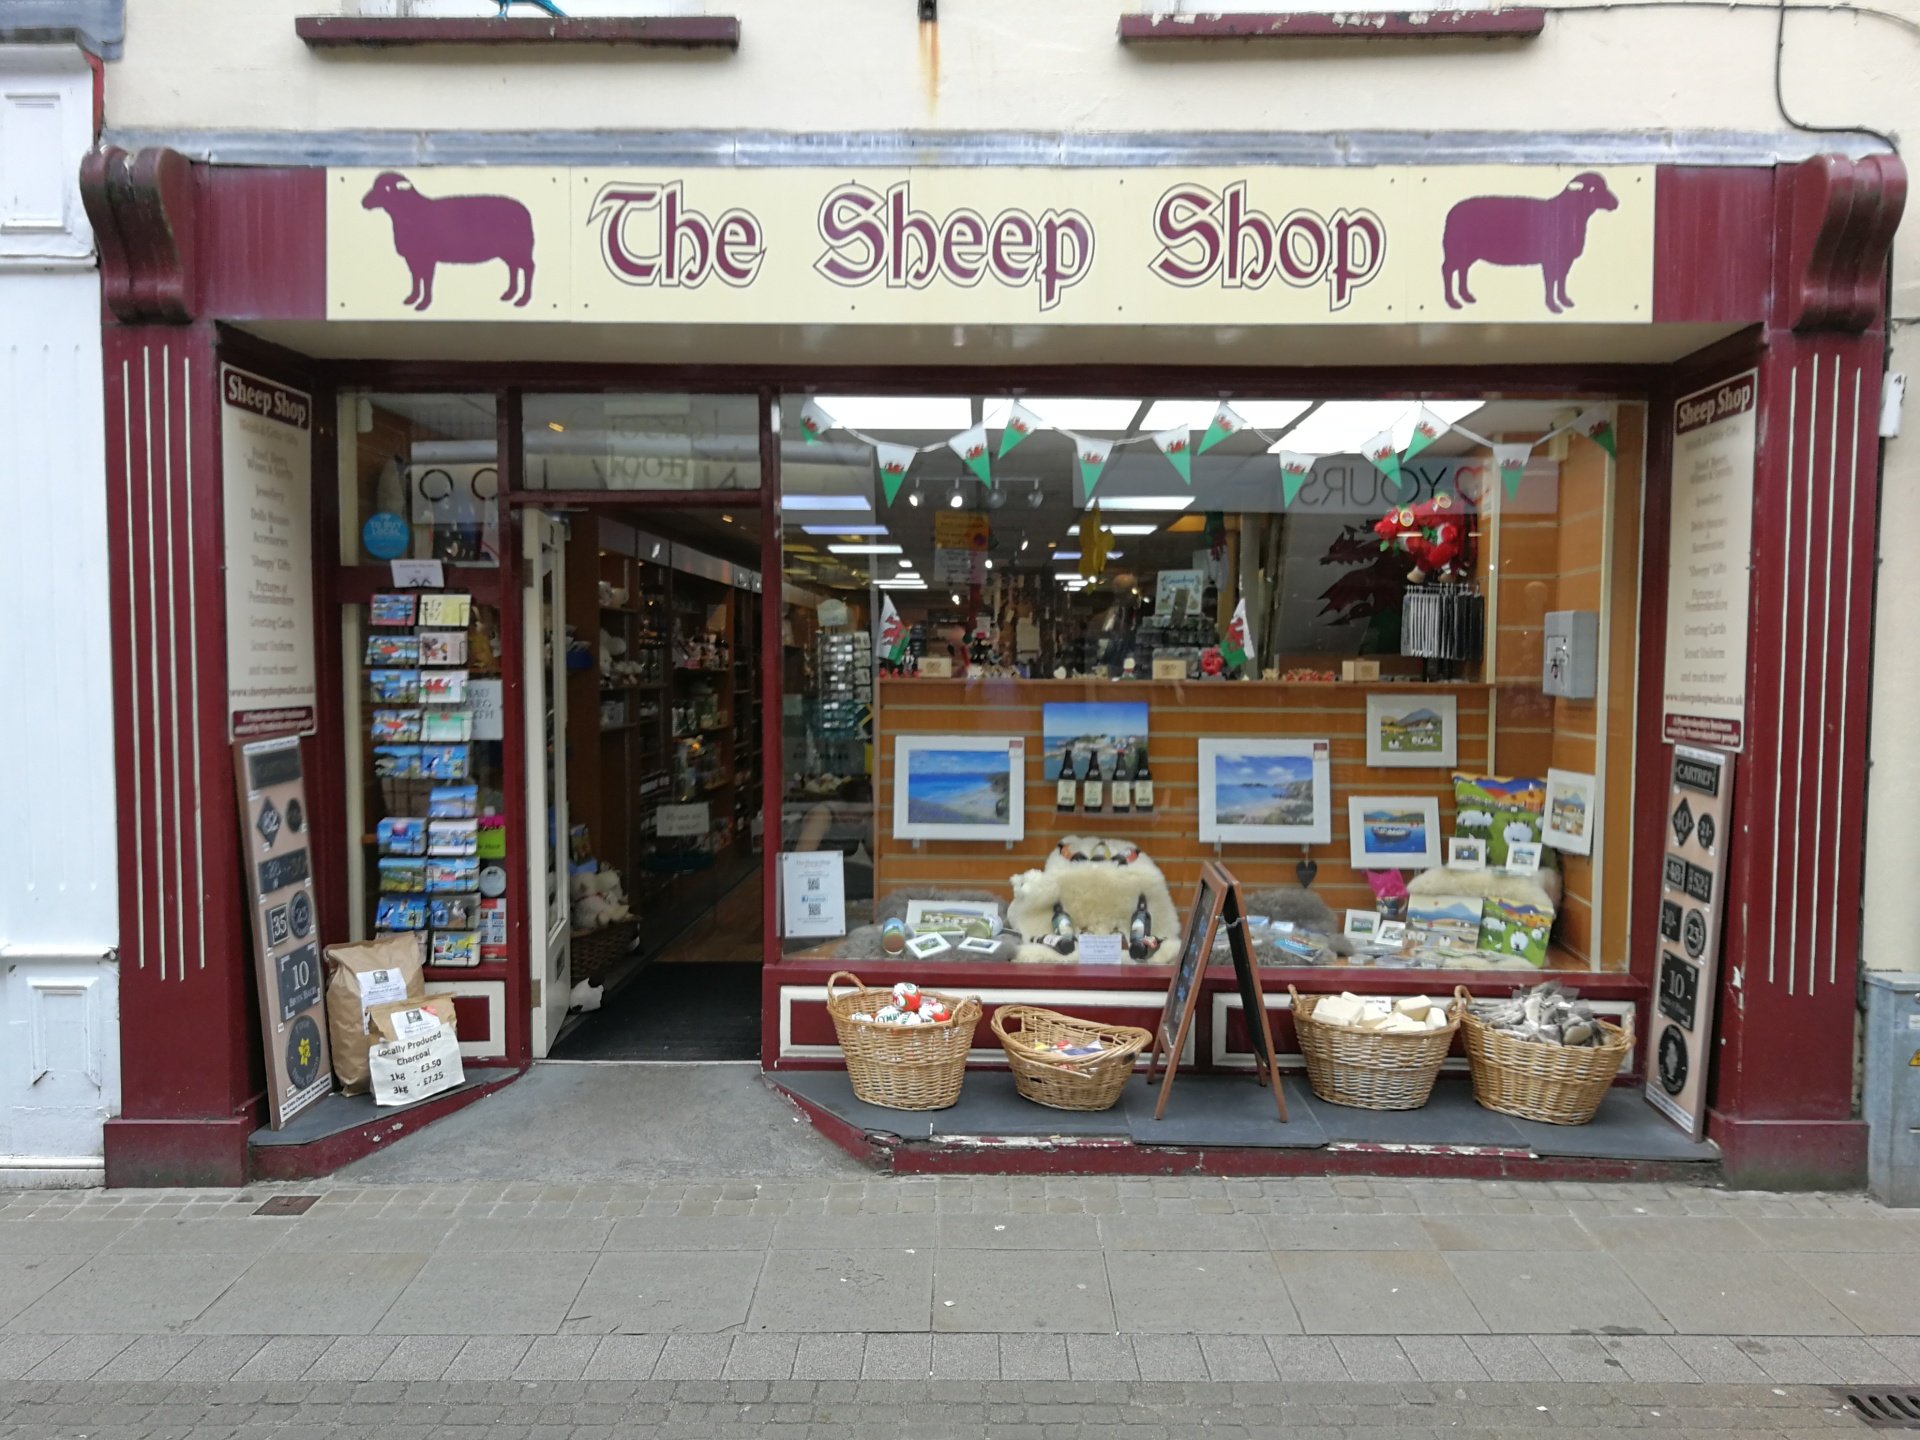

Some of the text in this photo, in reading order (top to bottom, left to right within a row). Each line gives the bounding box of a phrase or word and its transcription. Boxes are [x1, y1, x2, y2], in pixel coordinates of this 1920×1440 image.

[587, 180, 1387, 312] The Sheep Shop
[228, 374, 306, 426] Sheep Shop
[1679, 384, 1751, 428] Sheep Shop
[1675, 810, 1689, 831] 40
[272, 913, 288, 936] 35
[292, 960, 310, 992] 10
[1668, 969, 1685, 999] 10
[377, 1031, 442, 1057] Locally Produced
[396, 1048, 431, 1066] Charcoal
[389, 1072, 406, 1082] 1kg
[420, 1060, 442, 1073] £3.50
[393, 1085, 409, 1095] 3kg
[423, 1073, 444, 1086] £7.25
